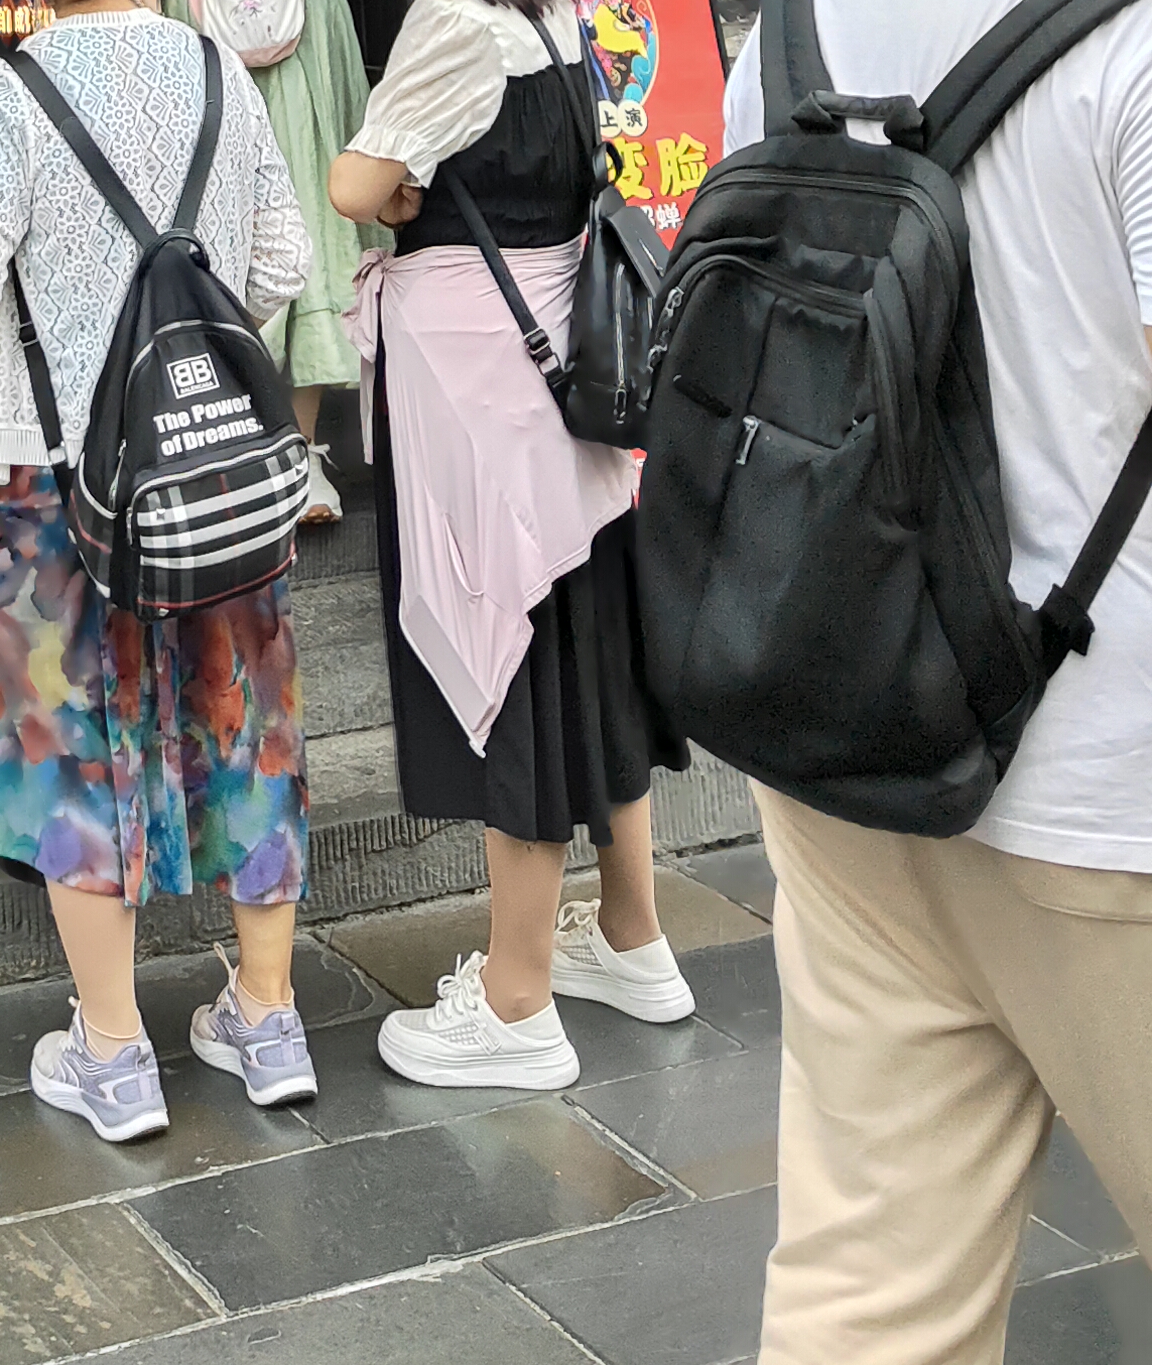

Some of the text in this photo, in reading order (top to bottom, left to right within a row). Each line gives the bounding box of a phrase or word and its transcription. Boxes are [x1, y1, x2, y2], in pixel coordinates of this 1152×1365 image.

[153, 394, 252, 434] The Power
[161, 417, 264, 456] of Dreams.
